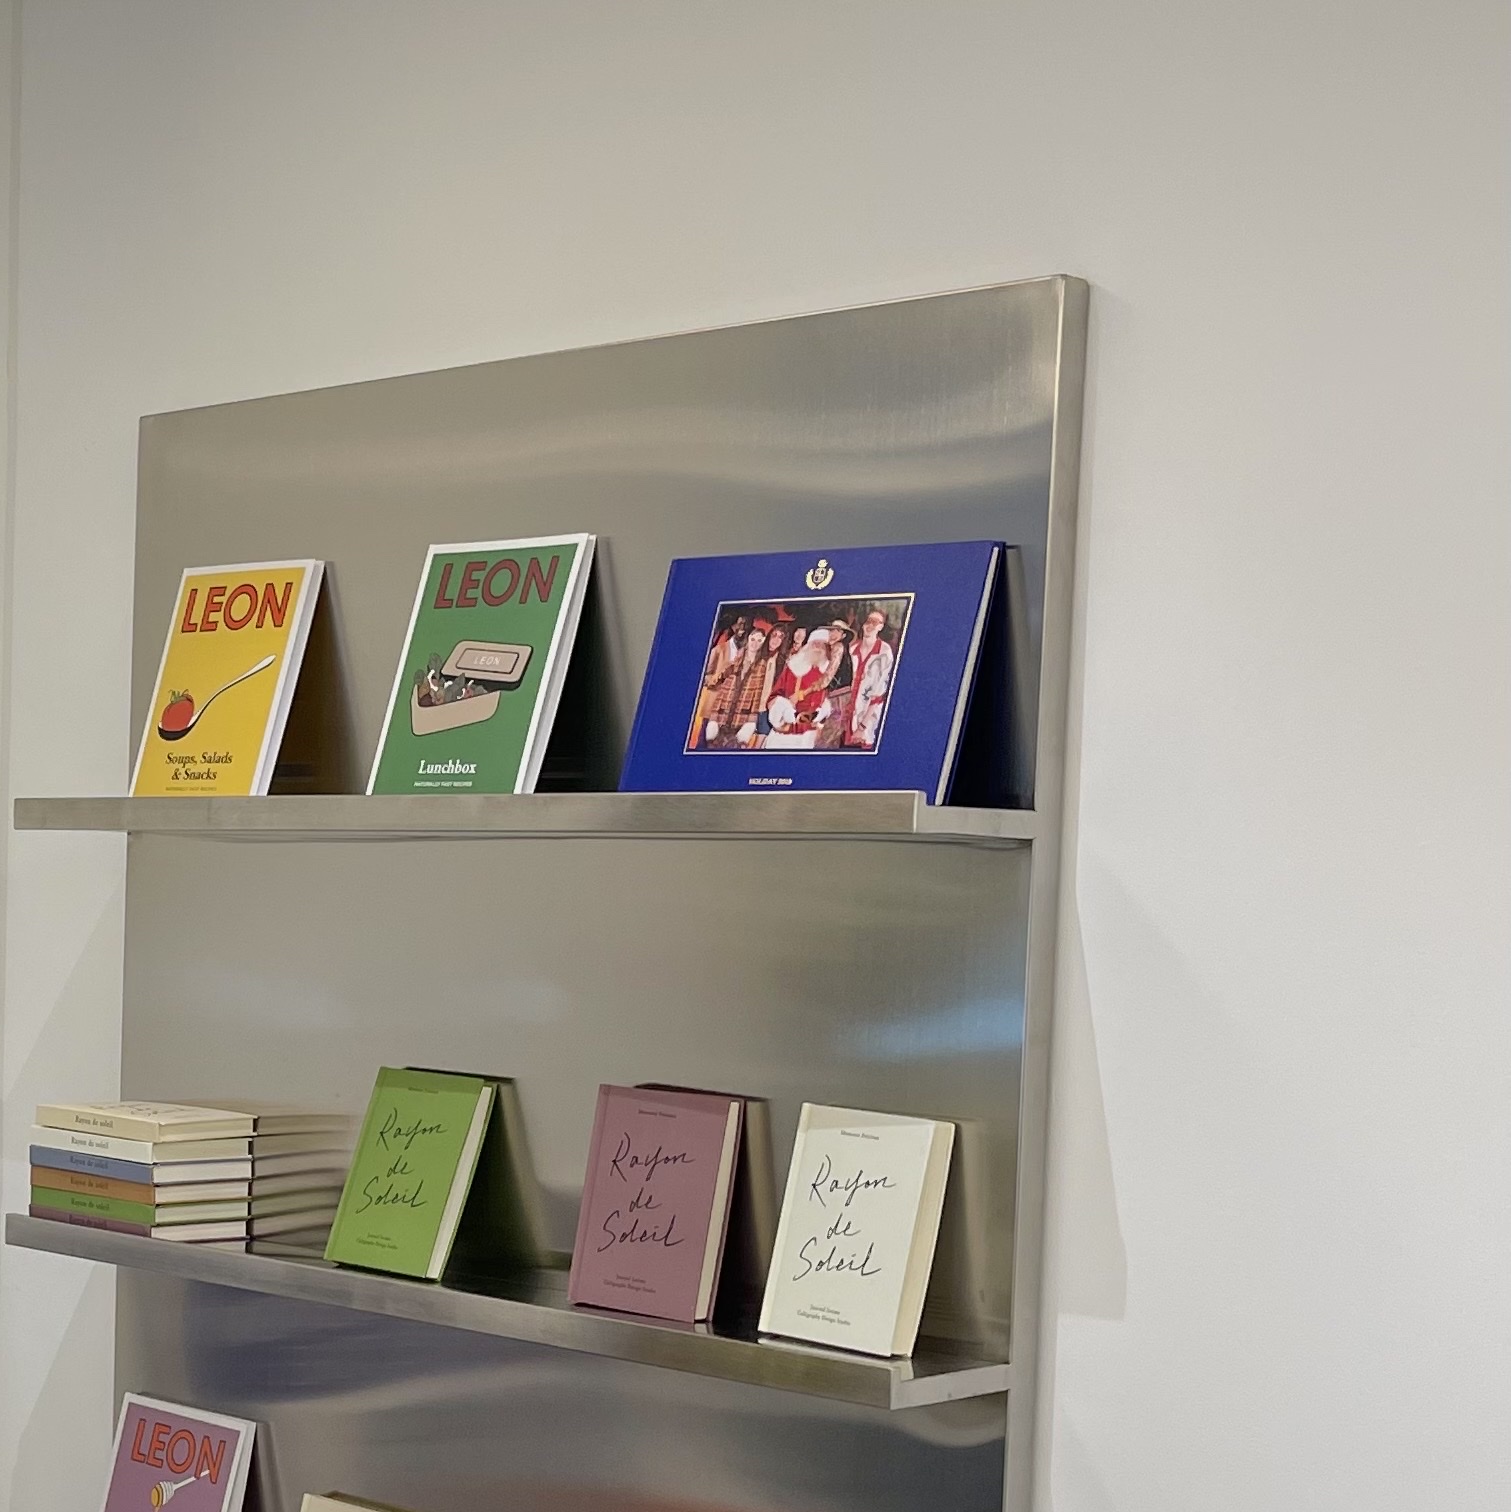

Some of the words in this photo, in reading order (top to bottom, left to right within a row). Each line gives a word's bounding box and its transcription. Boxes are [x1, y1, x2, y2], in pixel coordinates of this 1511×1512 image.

[434, 555, 560, 609] LEON
[181, 582, 293, 633] LEON
[474, 656, 501, 665] LEON
[171, 768, 181, 780] &
[183, 768, 217, 780] Snacks
[200, 751, 233, 764] Salads
[418, 759, 477, 774] Lunchbox
[376, 1107, 448, 1151] Rayon
[386, 1155, 416, 1178] de
[610, 1132, 696, 1182] Rayon
[355, 1176, 428, 1214] Soleil
[628, 1188, 662, 1212] de
[809, 1155, 896, 1207] Rayon
[596, 1211, 686, 1253] Soleil
[826, 1213, 862, 1239] de
[792, 1236, 883, 1282] Soleil
[131, 1418, 226, 1484] LEON
